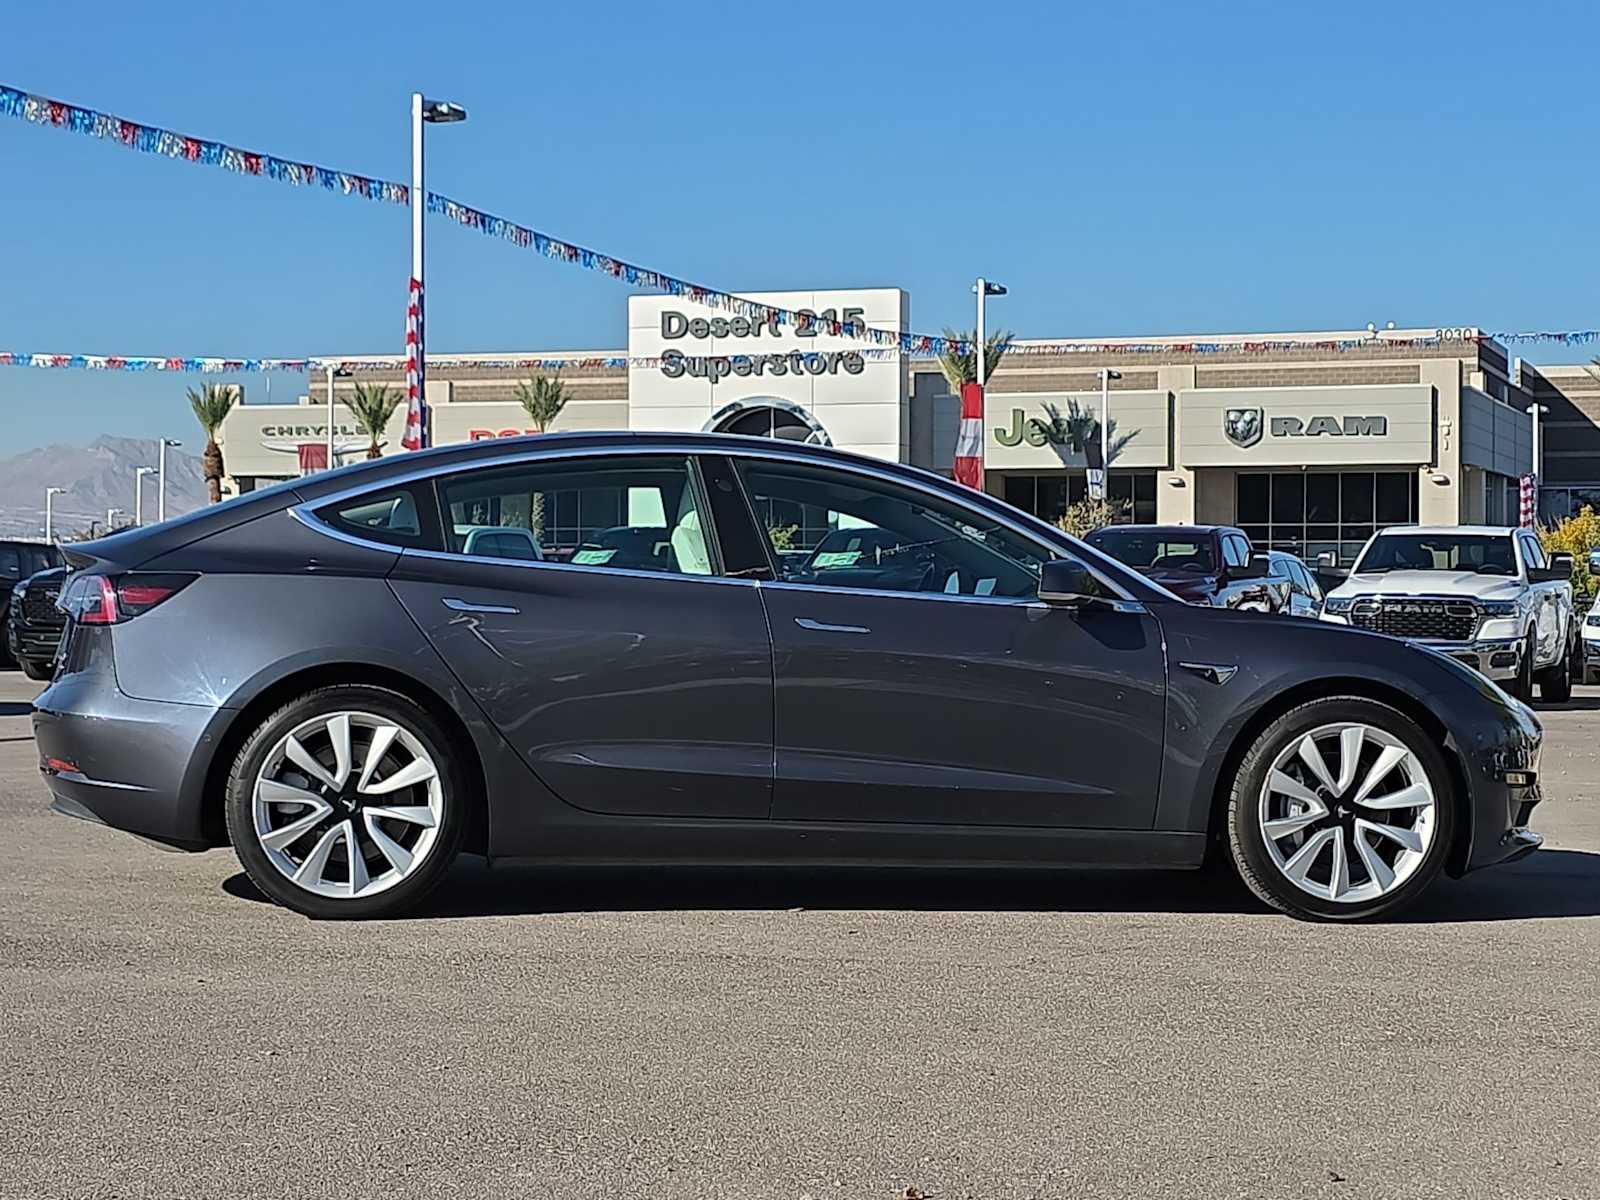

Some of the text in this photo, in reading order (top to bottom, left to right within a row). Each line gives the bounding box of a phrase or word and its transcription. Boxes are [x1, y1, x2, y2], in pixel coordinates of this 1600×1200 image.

[661, 307, 866, 339] Desert 215
[661, 349, 865, 383] Superstore
[261, 425, 386, 436] CHRYLE
[994, 408, 1098, 453] Jeep
[1270, 416, 1387, 437] RAM
[1383, 604, 1443, 613] RAM
